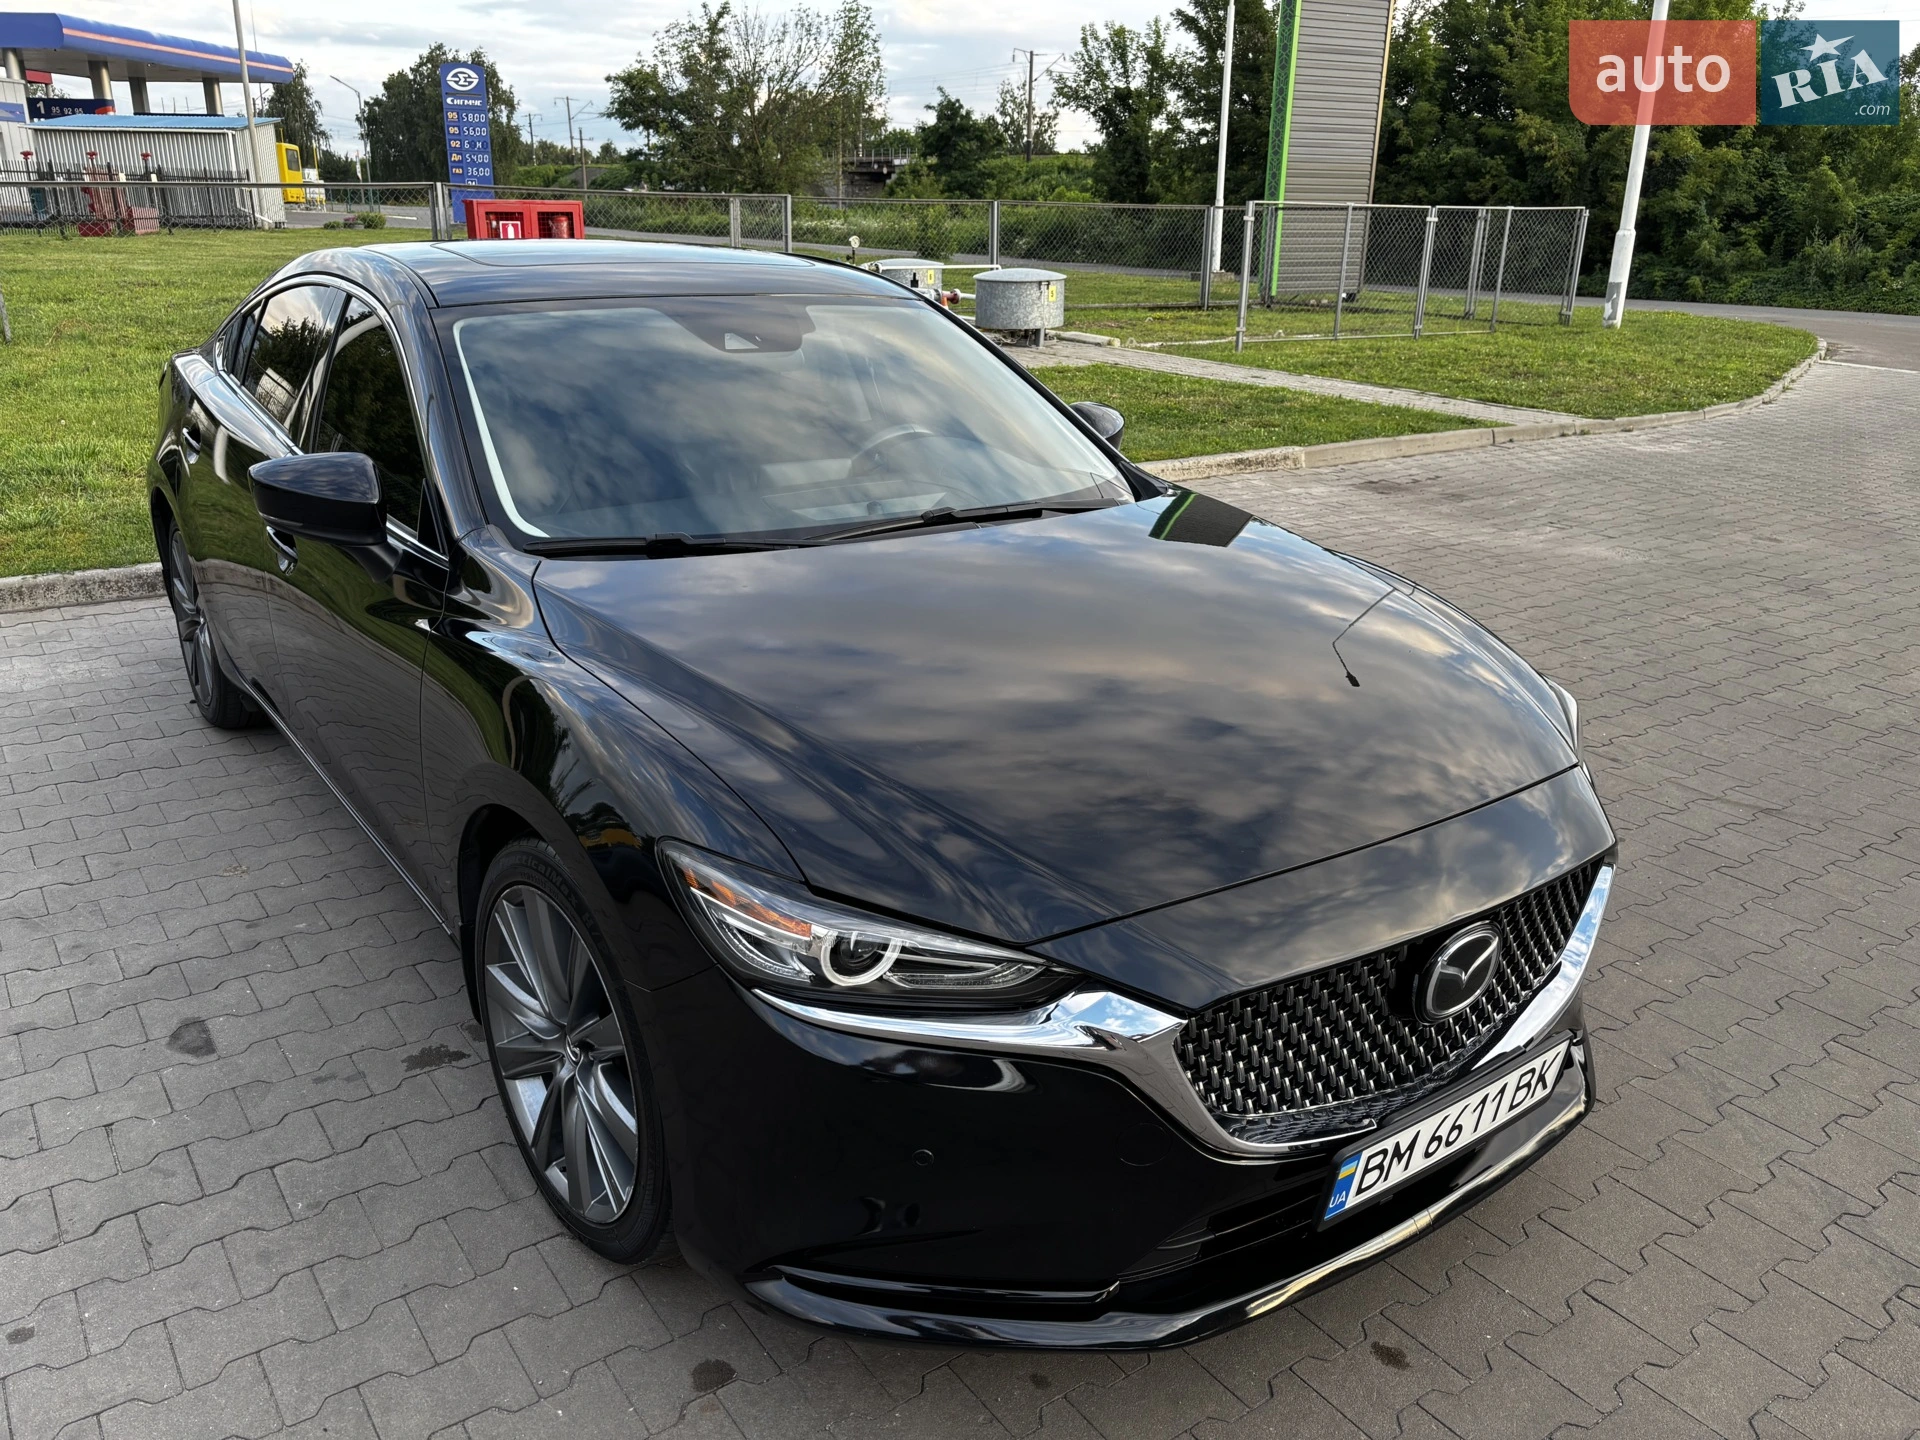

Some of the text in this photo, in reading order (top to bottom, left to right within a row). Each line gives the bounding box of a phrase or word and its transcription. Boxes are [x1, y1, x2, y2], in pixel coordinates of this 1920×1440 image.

[36, 101, 45, 114] 1
[63, 107, 72, 115] 92
[450, 140, 461, 148] 92
[467, 167, 490, 177] 36,00
[1355, 1051, 1561, 1197] BM 6611 BK
[1329, 1190, 1346, 1208] UA
